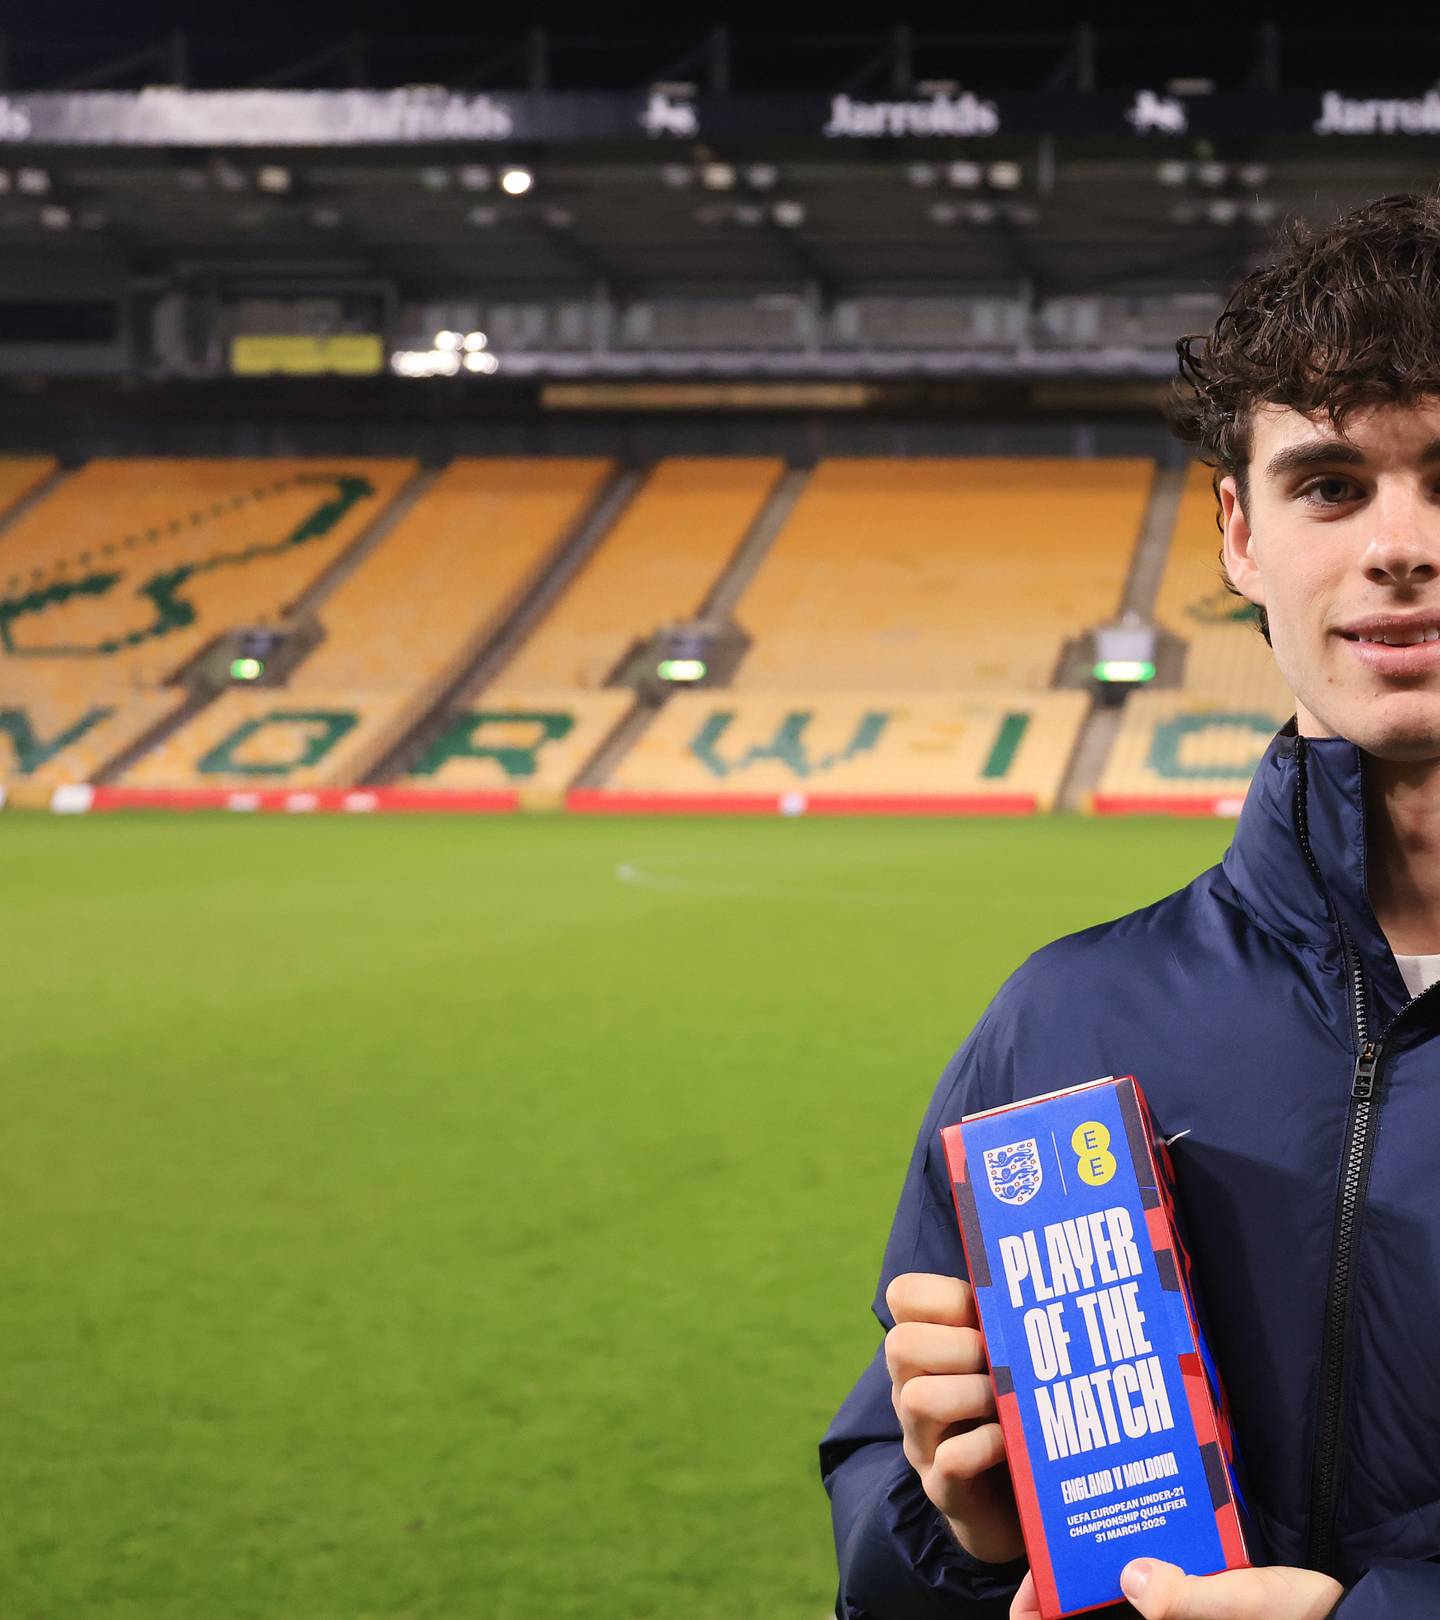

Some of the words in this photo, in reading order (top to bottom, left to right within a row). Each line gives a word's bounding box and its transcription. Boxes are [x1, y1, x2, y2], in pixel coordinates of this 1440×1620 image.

[823, 90, 999, 138] Jarrolds
[998, 1206, 1143, 1309] PLAYER
[1023, 1301, 1072, 1381] OF
[1075, 1281, 1153, 1367] THE
[1034, 1355, 1175, 1462] MATCH
[1060, 1469, 1114, 1505] ENGLAND
[1112, 1466, 1124, 1490] V
[1122, 1451, 1179, 1488] MOLDOVA
[1066, 1512, 1091, 1526] UEFA
[1090, 1498, 1140, 1519] EUROPEAN
[1139, 1486, 1185, 1506] UNDER-21
[1069, 1511, 1139, 1538] CHAMPIONSHIP
[1140, 1498, 1188, 1519] QUALIFIER
[1095, 1532, 1107, 1543] 31
[1106, 1522, 1141, 1540] MARCH
[1141, 1516, 1167, 1531] 2026
